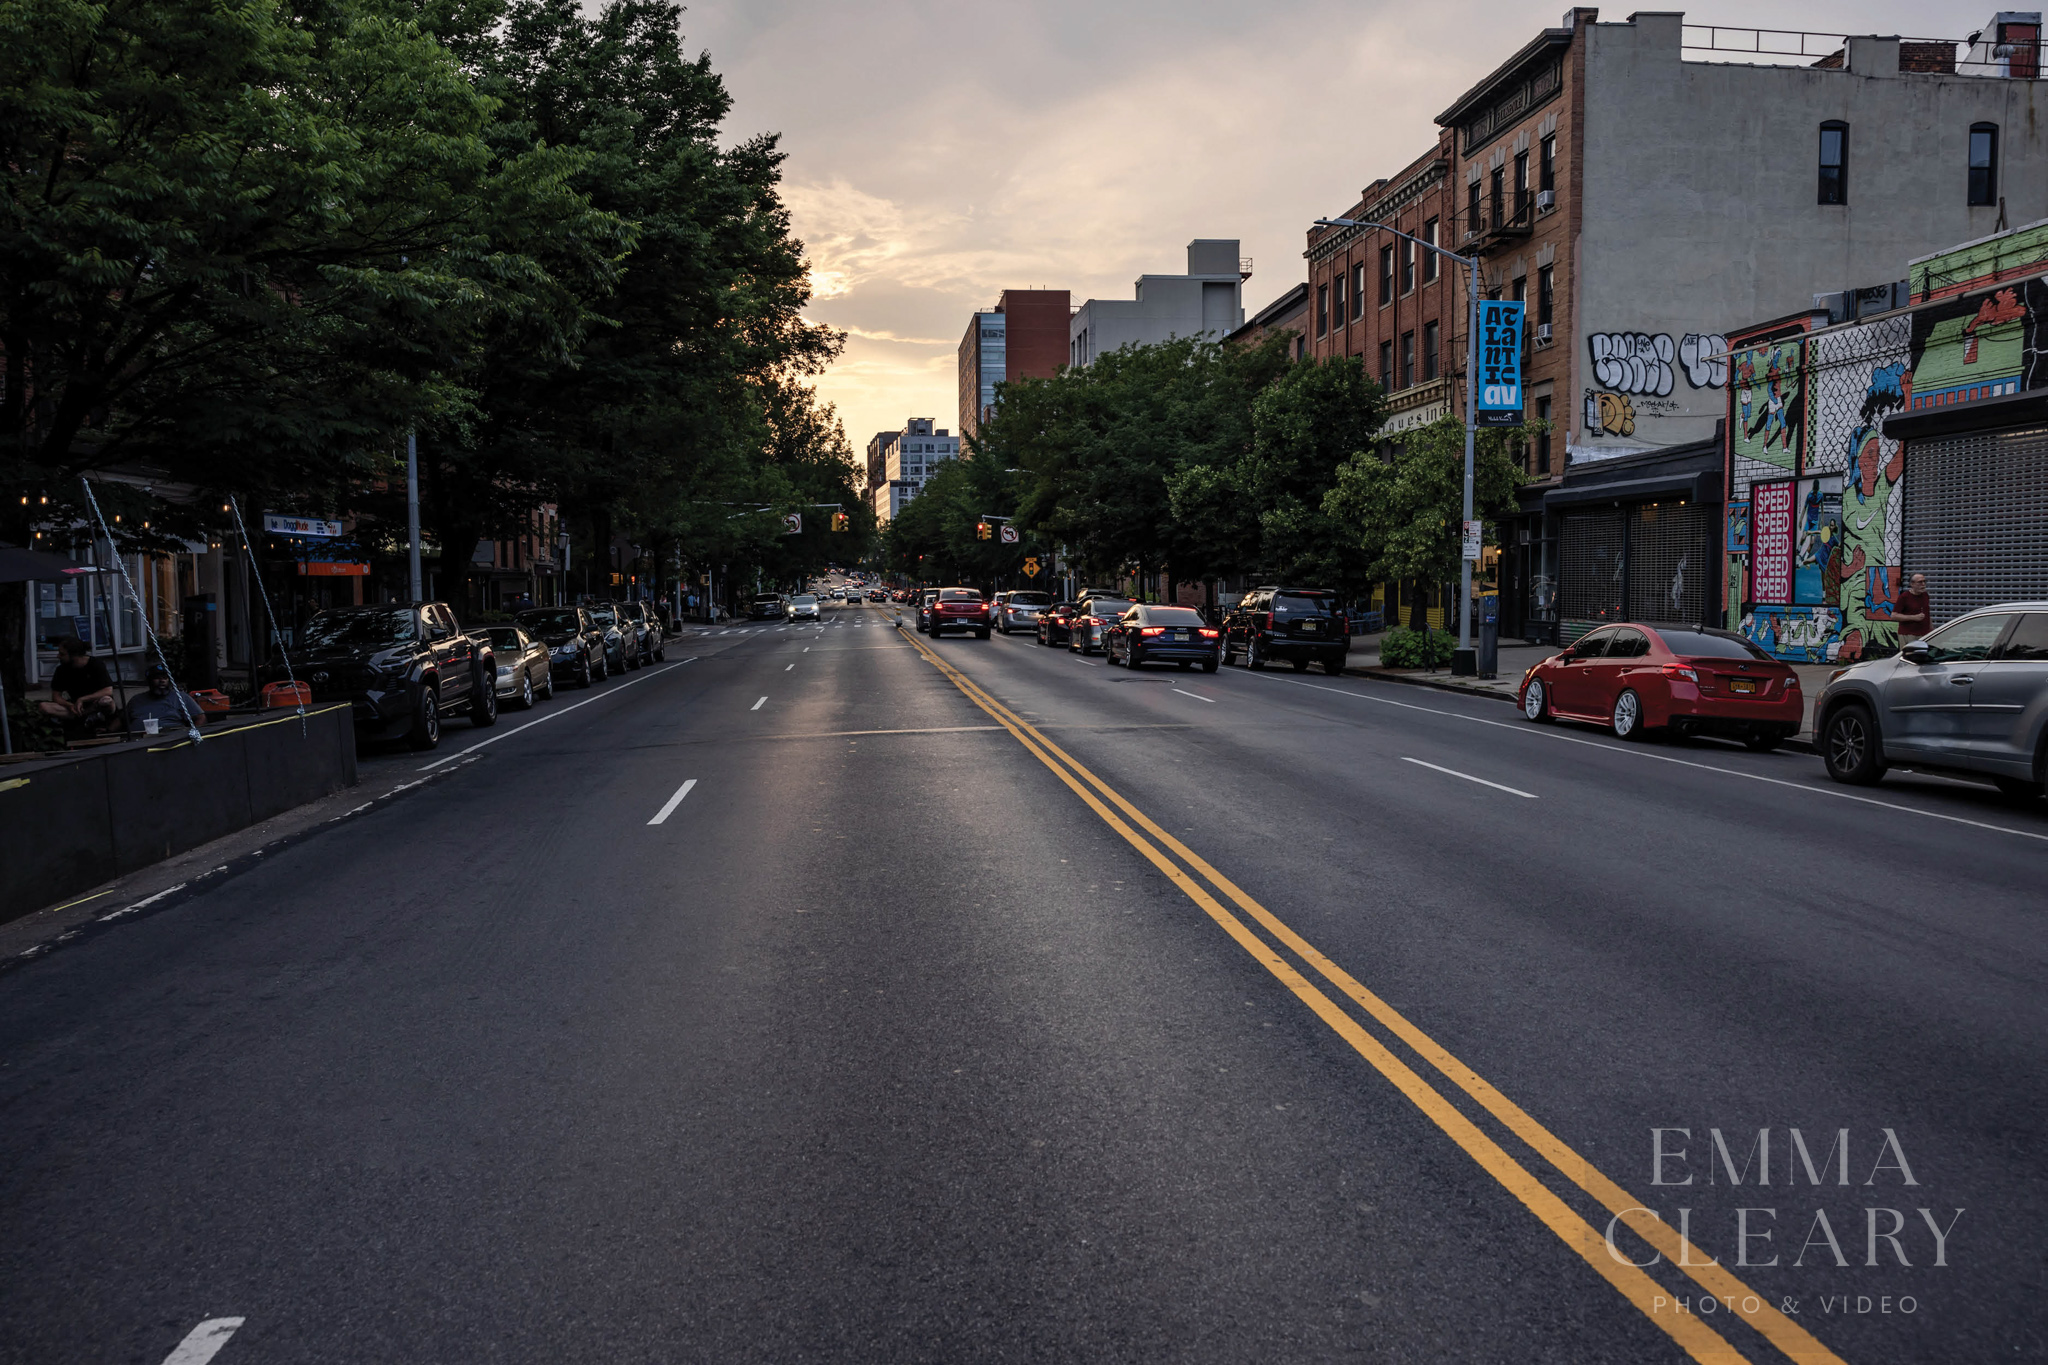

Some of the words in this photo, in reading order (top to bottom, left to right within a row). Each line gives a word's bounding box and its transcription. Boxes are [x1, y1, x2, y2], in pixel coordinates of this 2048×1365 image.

[1757, 489, 1790, 512] SPEED
[1757, 511, 1790, 534] SPEED
[1756, 533, 1790, 555] SPEED
[1756, 555, 1789, 577] SPEED
[1755, 577, 1788, 598] SPEED
